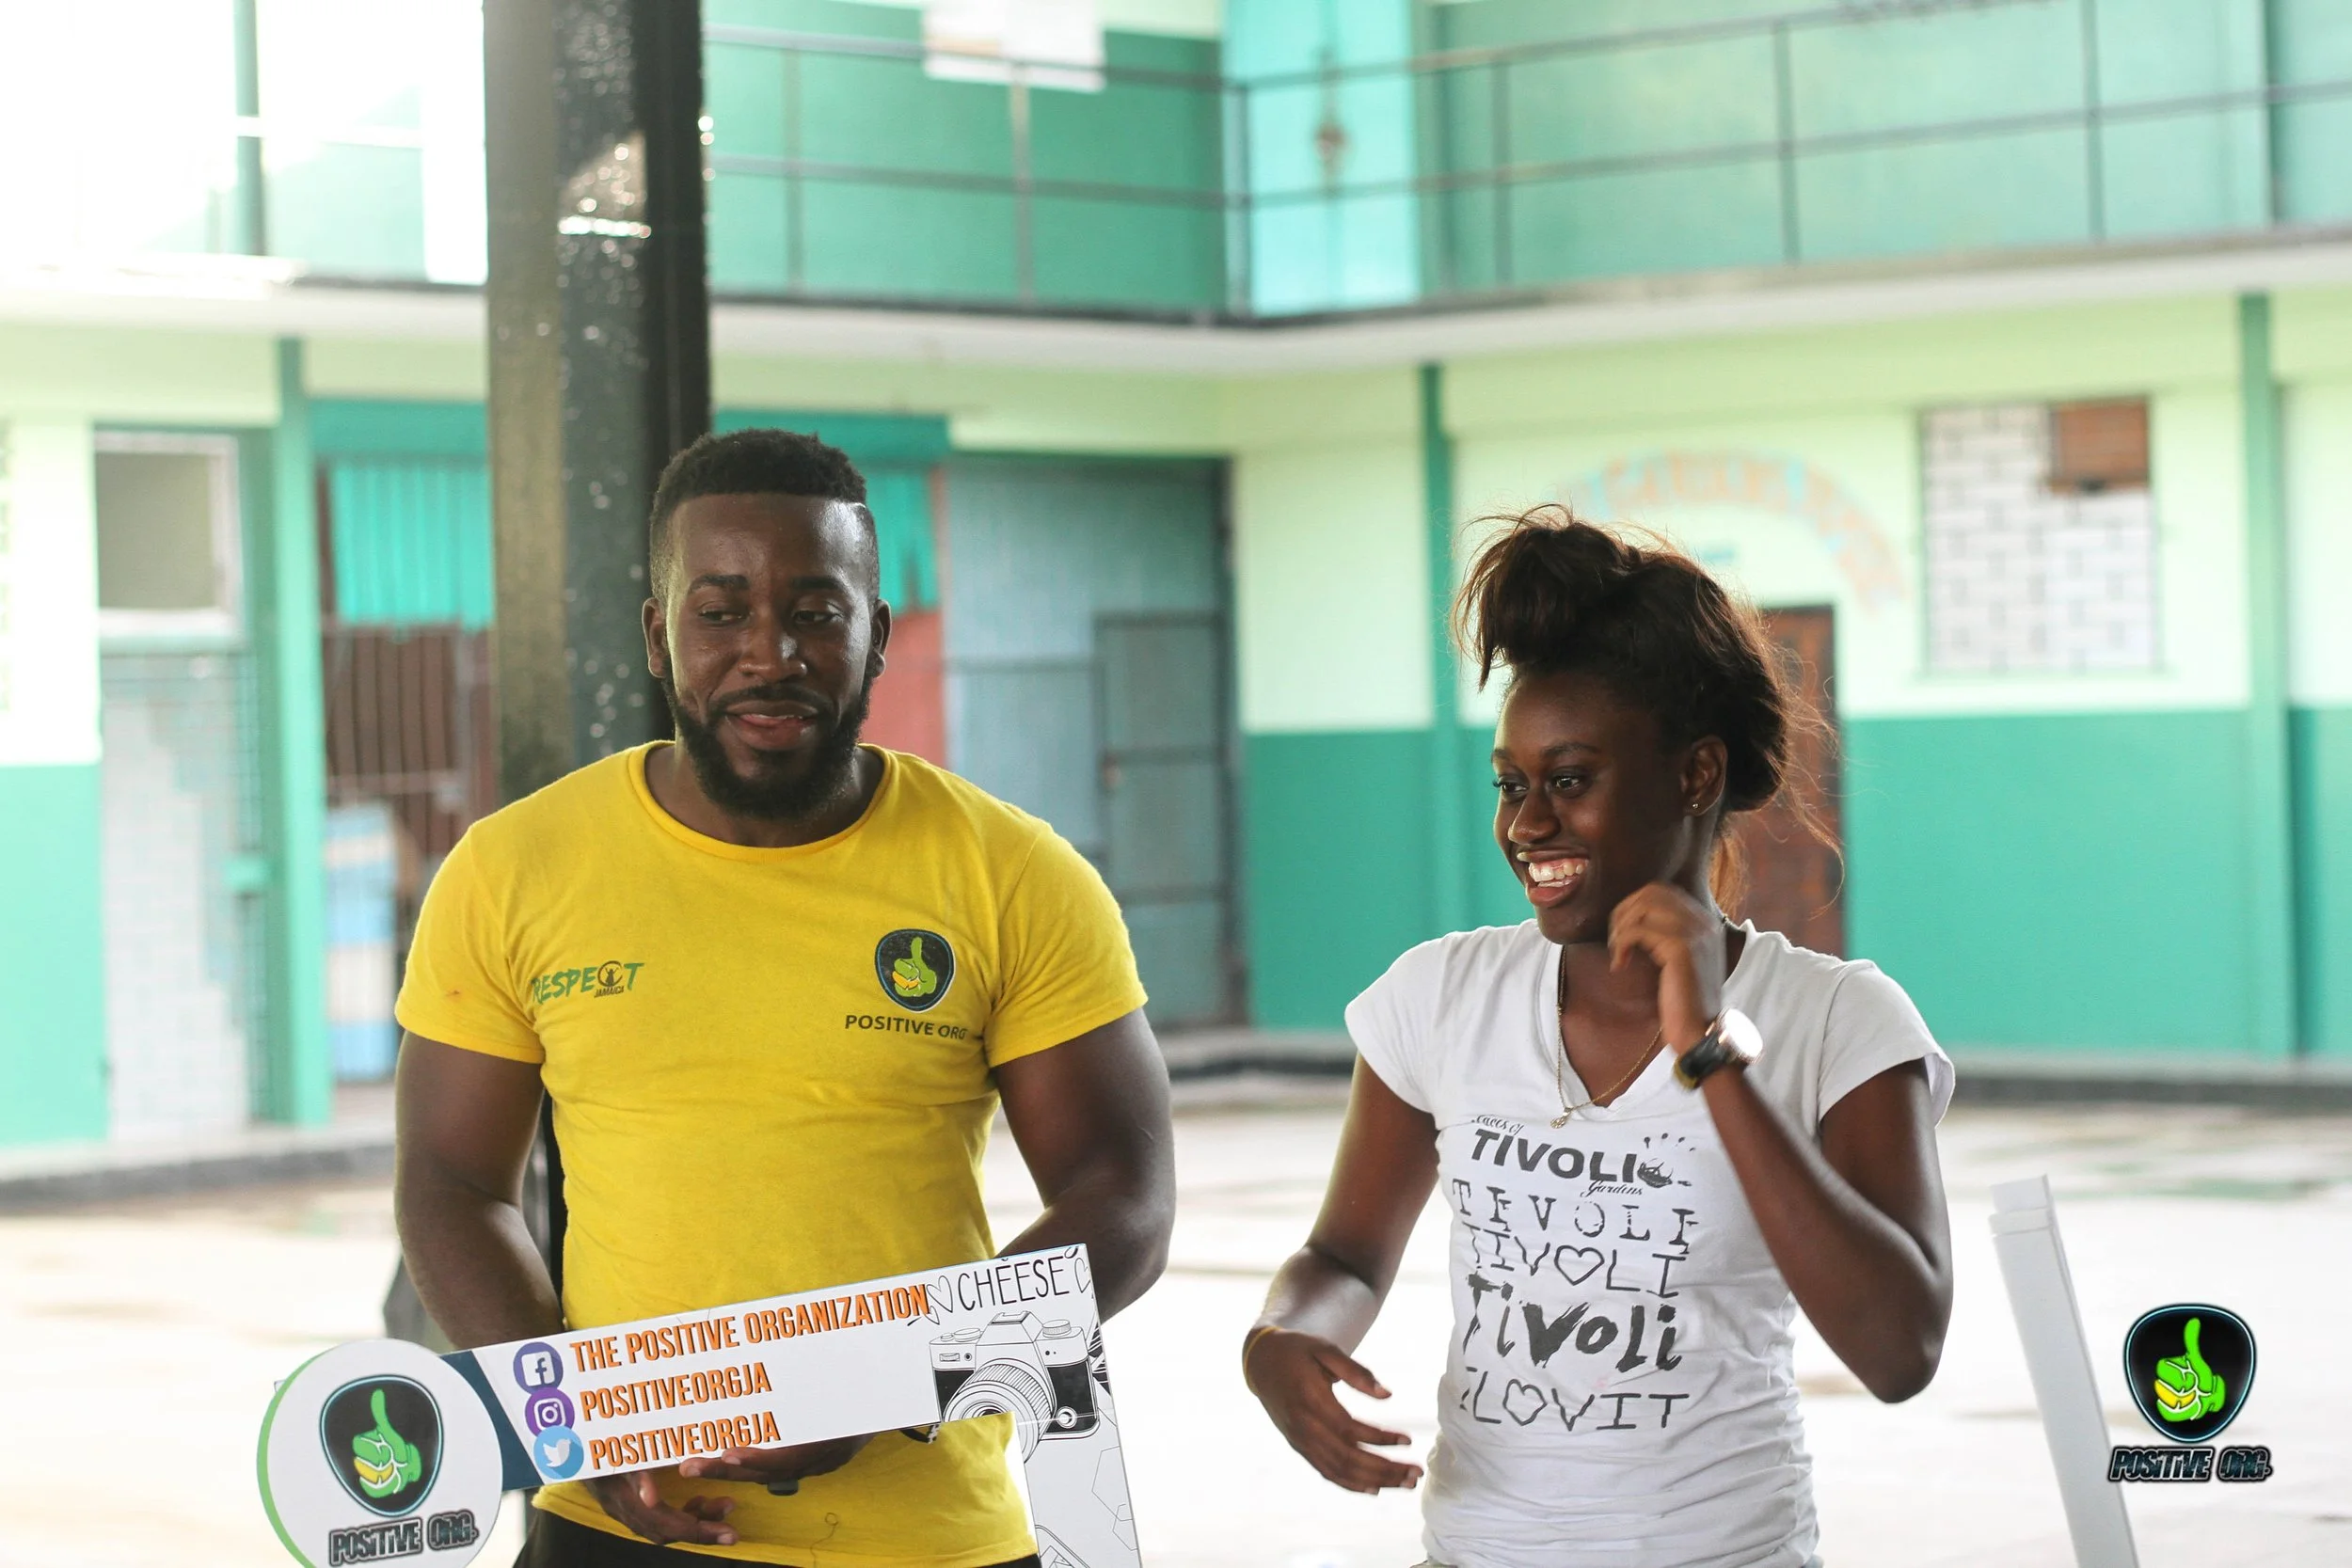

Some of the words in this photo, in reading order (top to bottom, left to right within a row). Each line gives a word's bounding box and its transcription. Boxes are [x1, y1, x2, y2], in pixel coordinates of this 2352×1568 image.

[530, 960, 644, 1005] RESPECT
[594, 986, 625, 998] JAMAICA
[845, 1014, 934, 1035] POSITIVE
[938, 1024, 968, 1040] ORG
[1470, 1128, 1637, 1183] TIVOLI
[1580, 1178, 1643, 1197] Gardens
[958, 1255, 1071, 1311] CHEESE
[569, 1336, 622, 1372] THE
[625, 1316, 739, 1364] POSITIVE
[743, 1283, 930, 1344] ORGANIZATION
[580, 1361, 772, 1421] POSITIVEORGJA
[589, 1411, 782, 1470] POSITIVEORGJA
